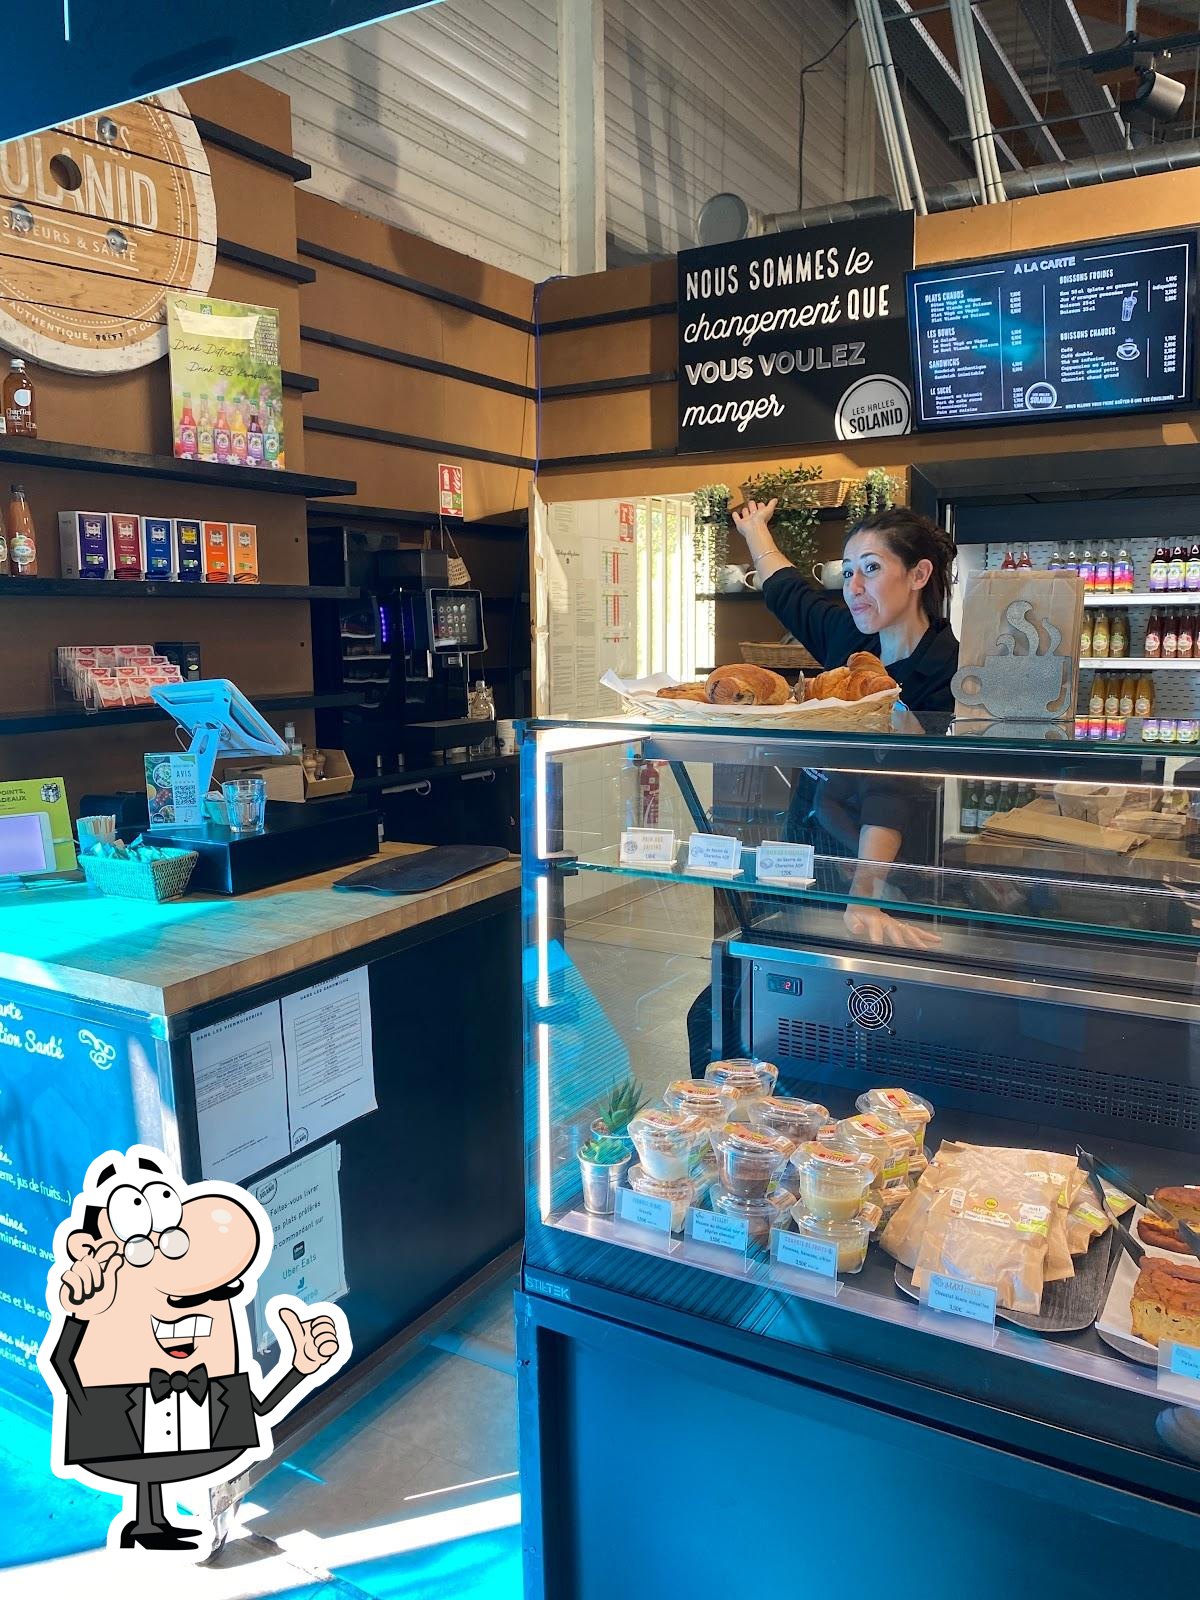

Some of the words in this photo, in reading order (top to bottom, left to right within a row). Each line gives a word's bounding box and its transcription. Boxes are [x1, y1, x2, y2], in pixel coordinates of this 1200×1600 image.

[686, 264, 739, 301] NOUS
[750, 247, 839, 291] SOMMES
[845, 247, 873, 276] le
[1024, 261, 1039, 274] LA
[1040, 256, 1076, 270] CARTE
[1060, 273, 1088, 284] BOISSONS
[1089, 269, 1114, 280] FROIDES
[684, 295, 841, 347] changement
[847, 284, 890, 321] QUE
[926, 329, 936, 338] LES
[1060, 330, 1087, 341] BOISSONS
[1090, 326, 1115, 337] CHAUDES
[685, 356, 754, 386] VOUS
[758, 341, 866, 377] VOULEZ
[928, 357, 959, 368] SANDWICHS
[682, 393, 785, 433] manger
[852, 406, 866, 416] LES
[868, 399, 895, 413] HALLES
[850, 407, 903, 434] SOLANID
[25, 1029, 65, 1060] Santé
[16, 1172, 29, 1191] jus
[29, 1177, 40, 1193] de
[283, 1214, 297, 1231] plats
[39, 1248, 56, 1263] ave
[282, 1264, 301, 1280] Uber
[301, 1254, 317, 1268] Eats
[23, 1297, 36, 1315] les
